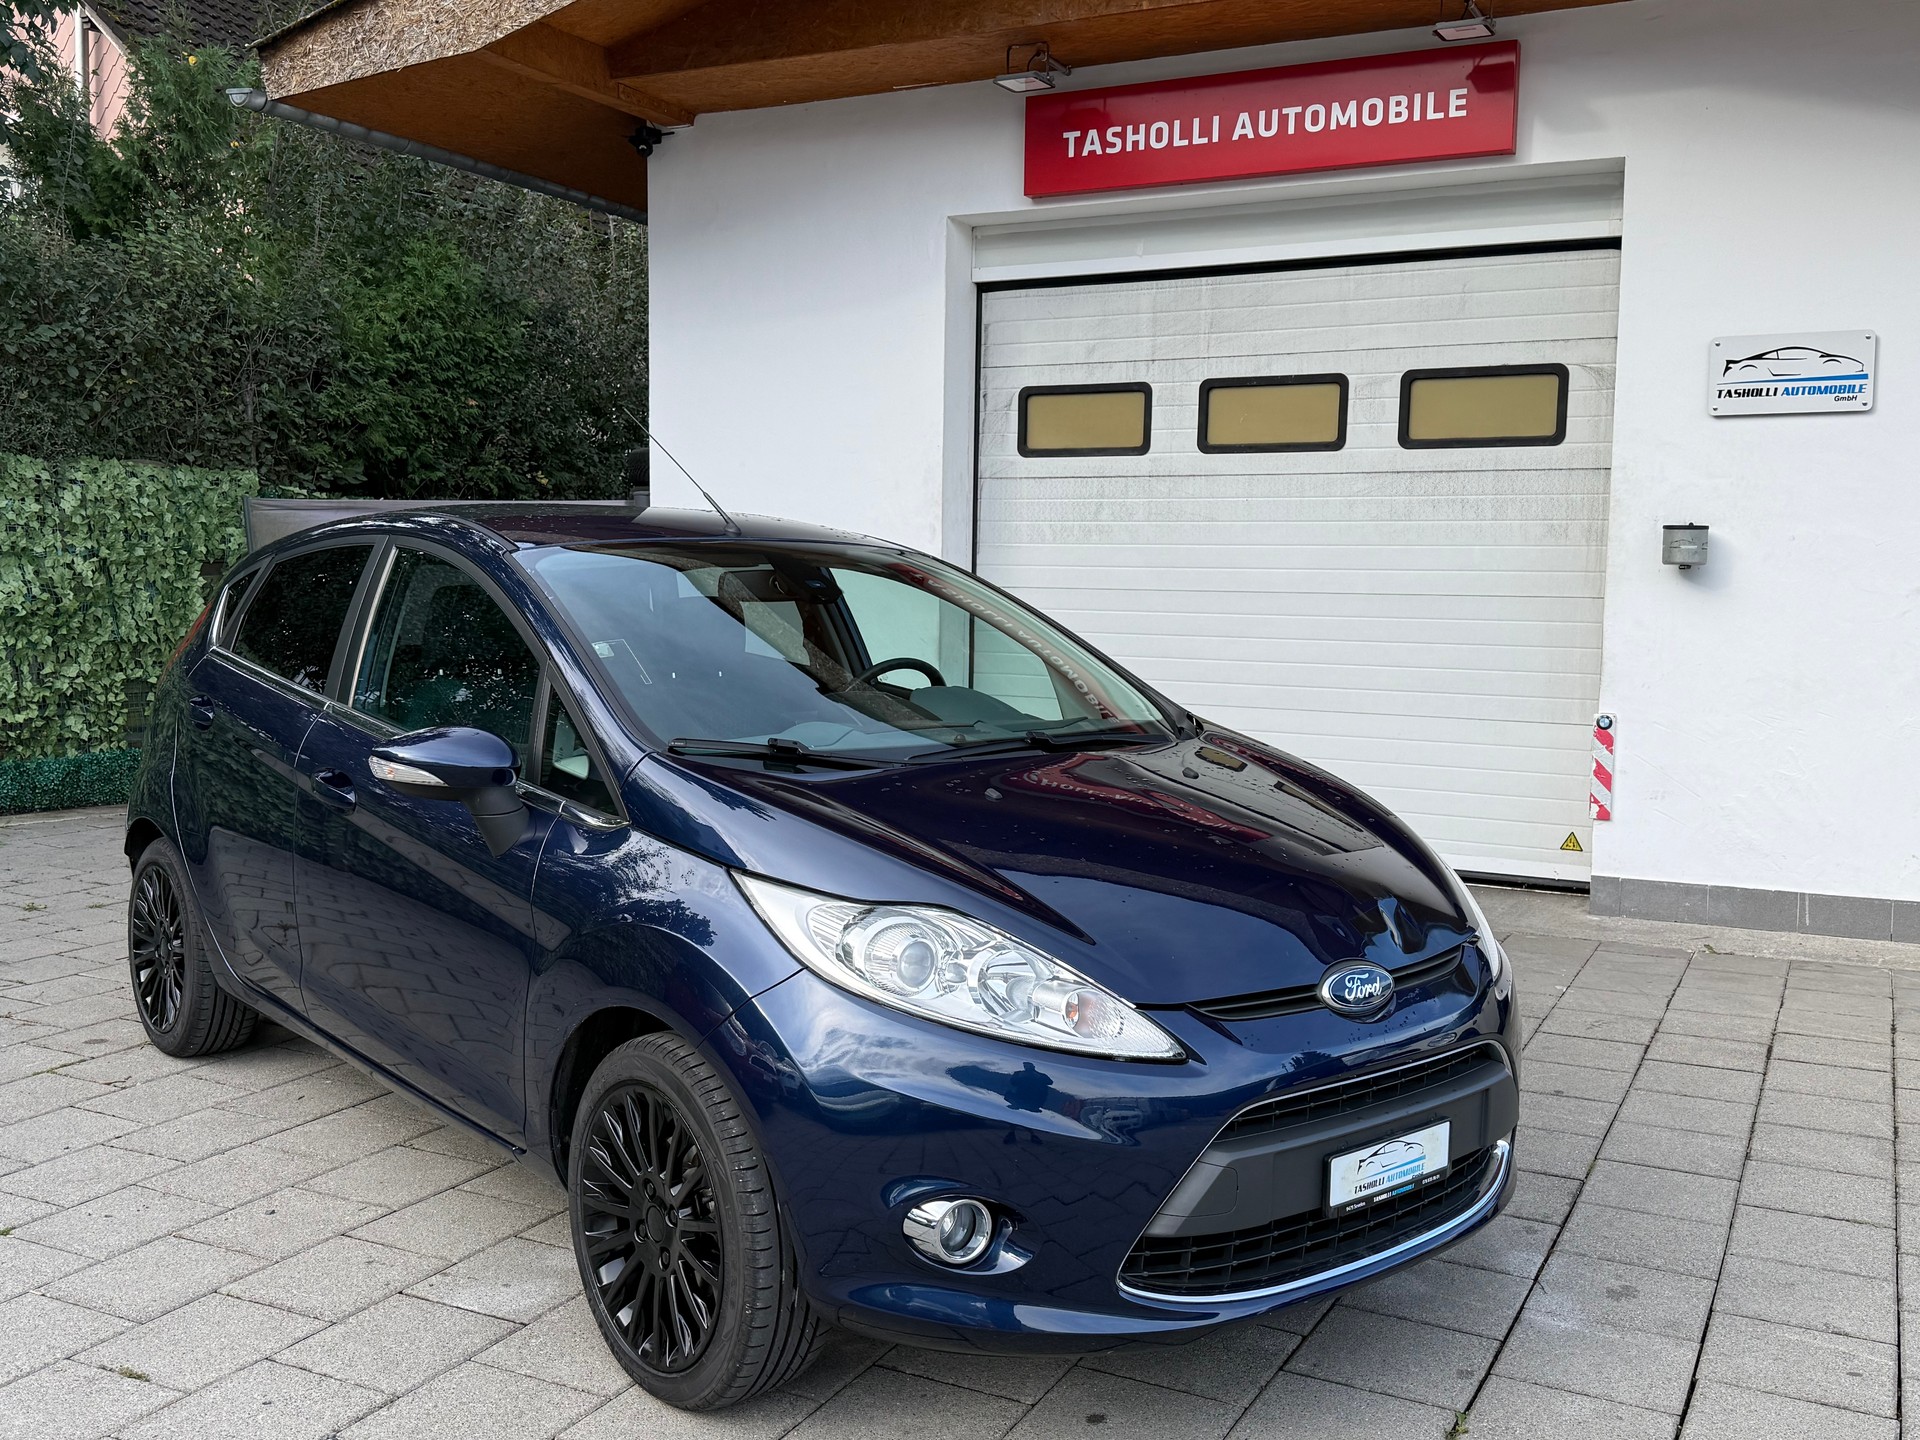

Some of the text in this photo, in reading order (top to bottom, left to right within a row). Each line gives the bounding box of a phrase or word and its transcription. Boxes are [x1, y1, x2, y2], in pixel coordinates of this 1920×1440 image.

[1062, 87, 1469, 158] TASHOLLI AUTOMOBILE
[1716, 383, 1868, 399] TASHOLLI AUTOMOBILE
[1344, 972, 1383, 1001] Ford
[1354, 1176, 1386, 1194] TASHOLLI
[1386, 1162, 1425, 1183] AUTOMOBILE
